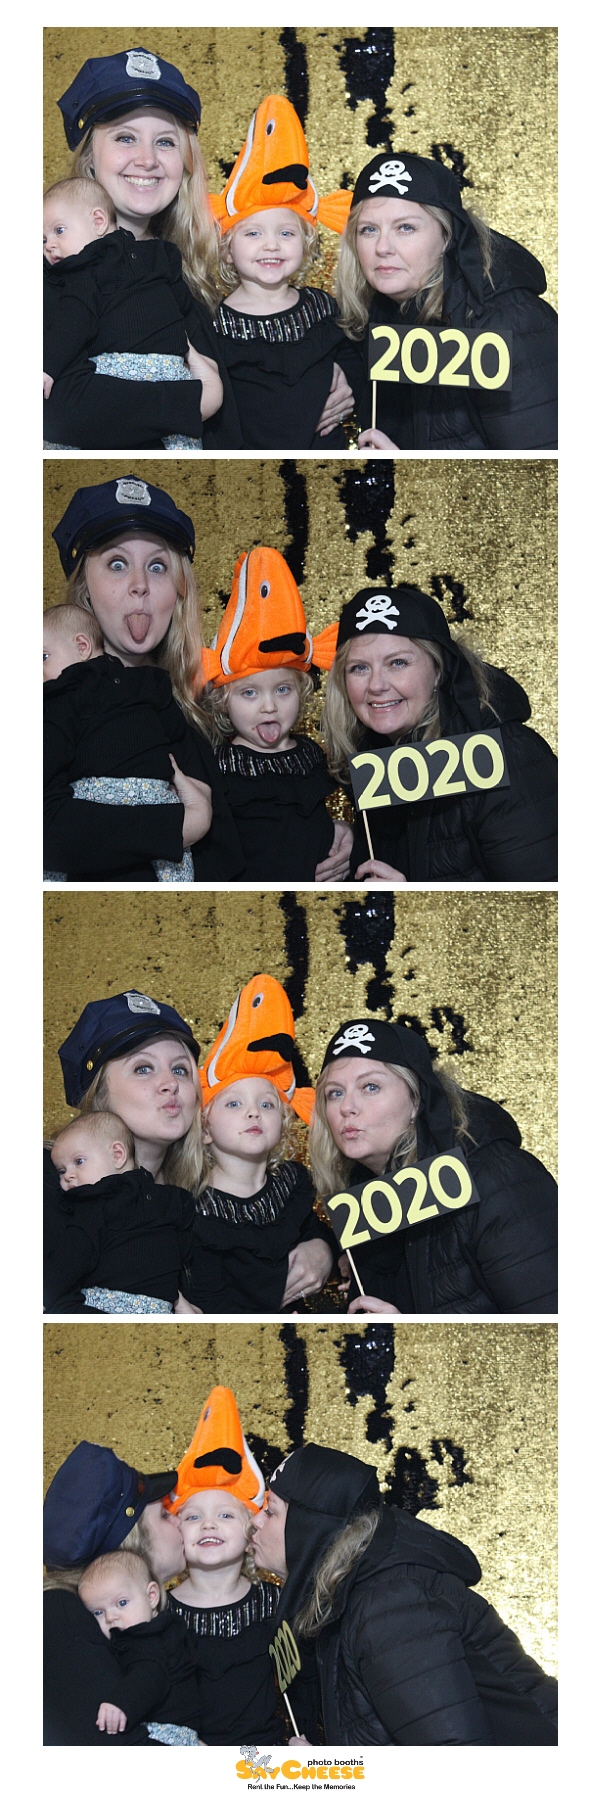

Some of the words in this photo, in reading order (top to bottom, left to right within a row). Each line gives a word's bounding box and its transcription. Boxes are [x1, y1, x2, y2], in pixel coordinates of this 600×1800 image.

[370, 325, 510, 390] 2020
[351, 734, 505, 810] 2020
[327, 1155, 473, 1250] 2020
[268, 1620, 301, 1694] 2020
